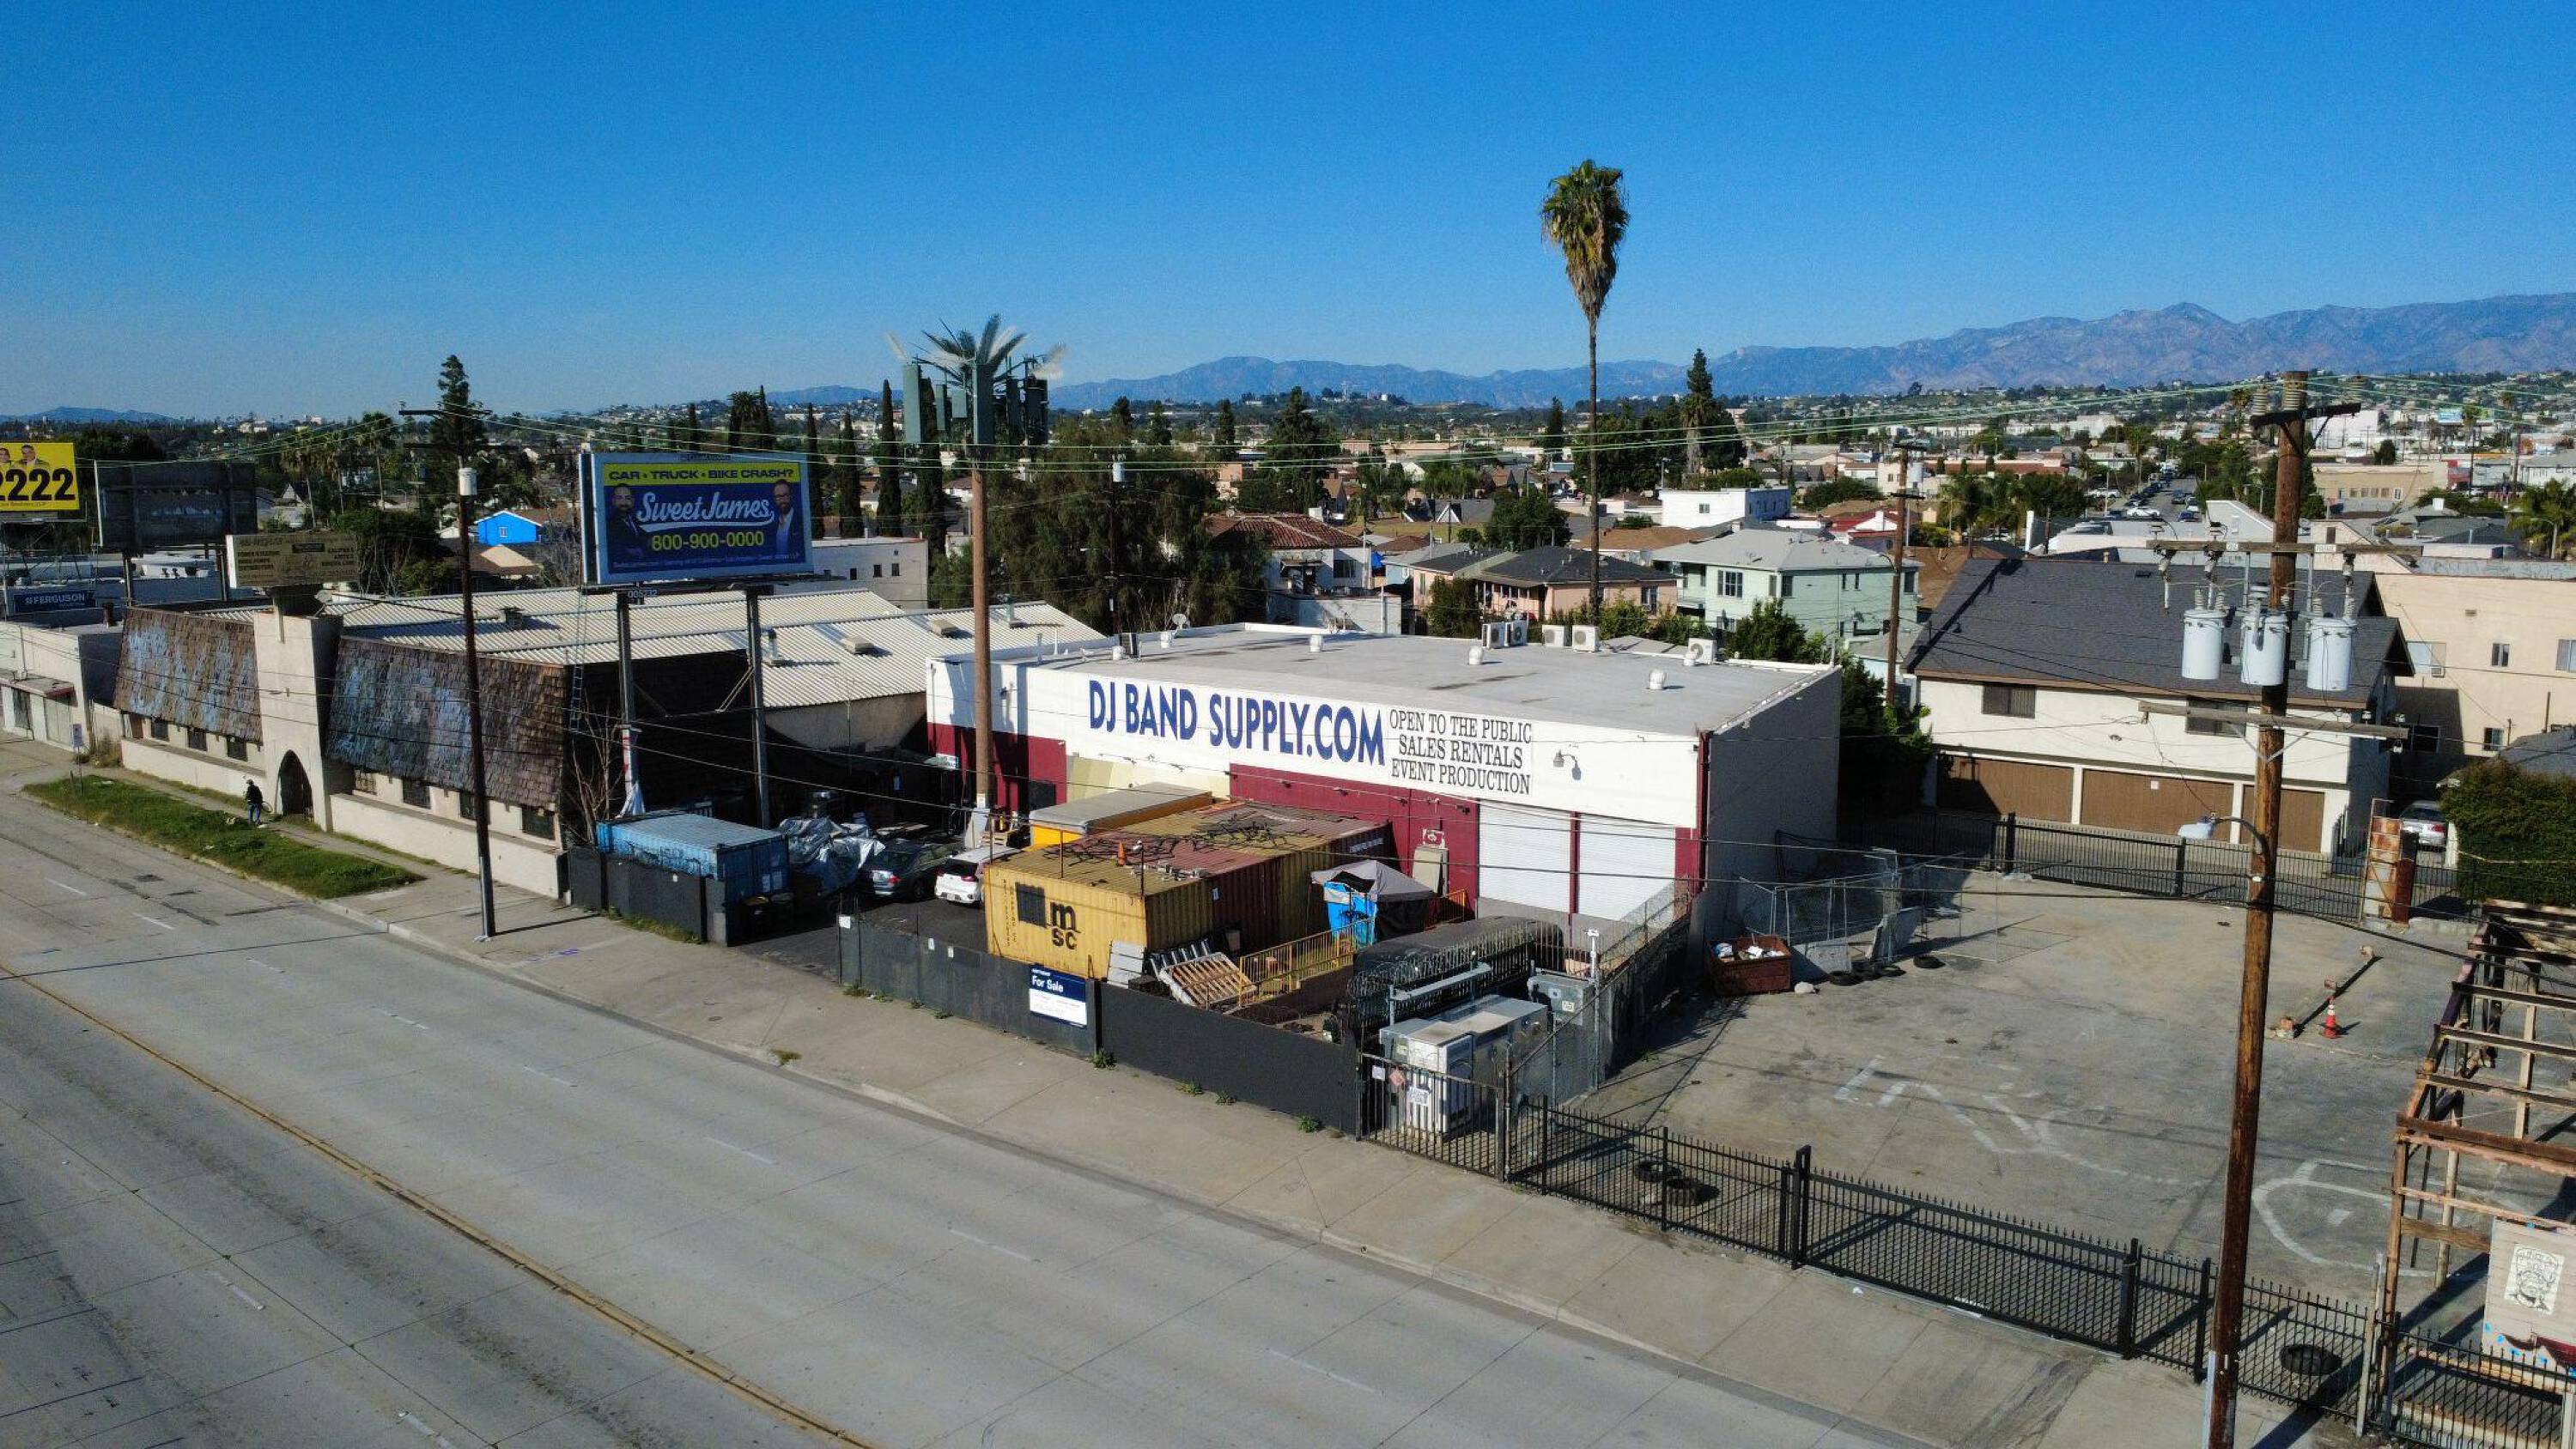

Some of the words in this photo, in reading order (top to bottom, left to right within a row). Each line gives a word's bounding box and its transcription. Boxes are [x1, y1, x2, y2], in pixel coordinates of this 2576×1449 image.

[609, 470, 640, 480] CAR
[651, 470, 699, 479] TRUCK
[708, 470, 738, 478] BIKE
[741, 468, 793, 478] CRASH?
[637, 492, 703, 523] Sweet
[701, 491, 775, 520] James
[653, 530, 764, 551] 800-900-0000
[1089, 680, 1115, 733] DJ
[1125, 683, 1199, 741] BAND
[1209, 693, 1385, 767] SUPPLY.COM
[1389, 709, 1426, 731] OPEN
[1428, 713, 1446, 735] TO
[1449, 716, 1478, 738] THE
[1481, 719, 1532, 744] PUBLIC
[1399, 734, 1446, 761] SALES
[1450, 740, 1523, 769] RENTALS
[1391, 758, 1436, 782] EVENT
[1439, 764, 1531, 795] PRODUCTION
[1032, 974, 1045, 987] For
[1047, 979, 1064, 993] Sale
